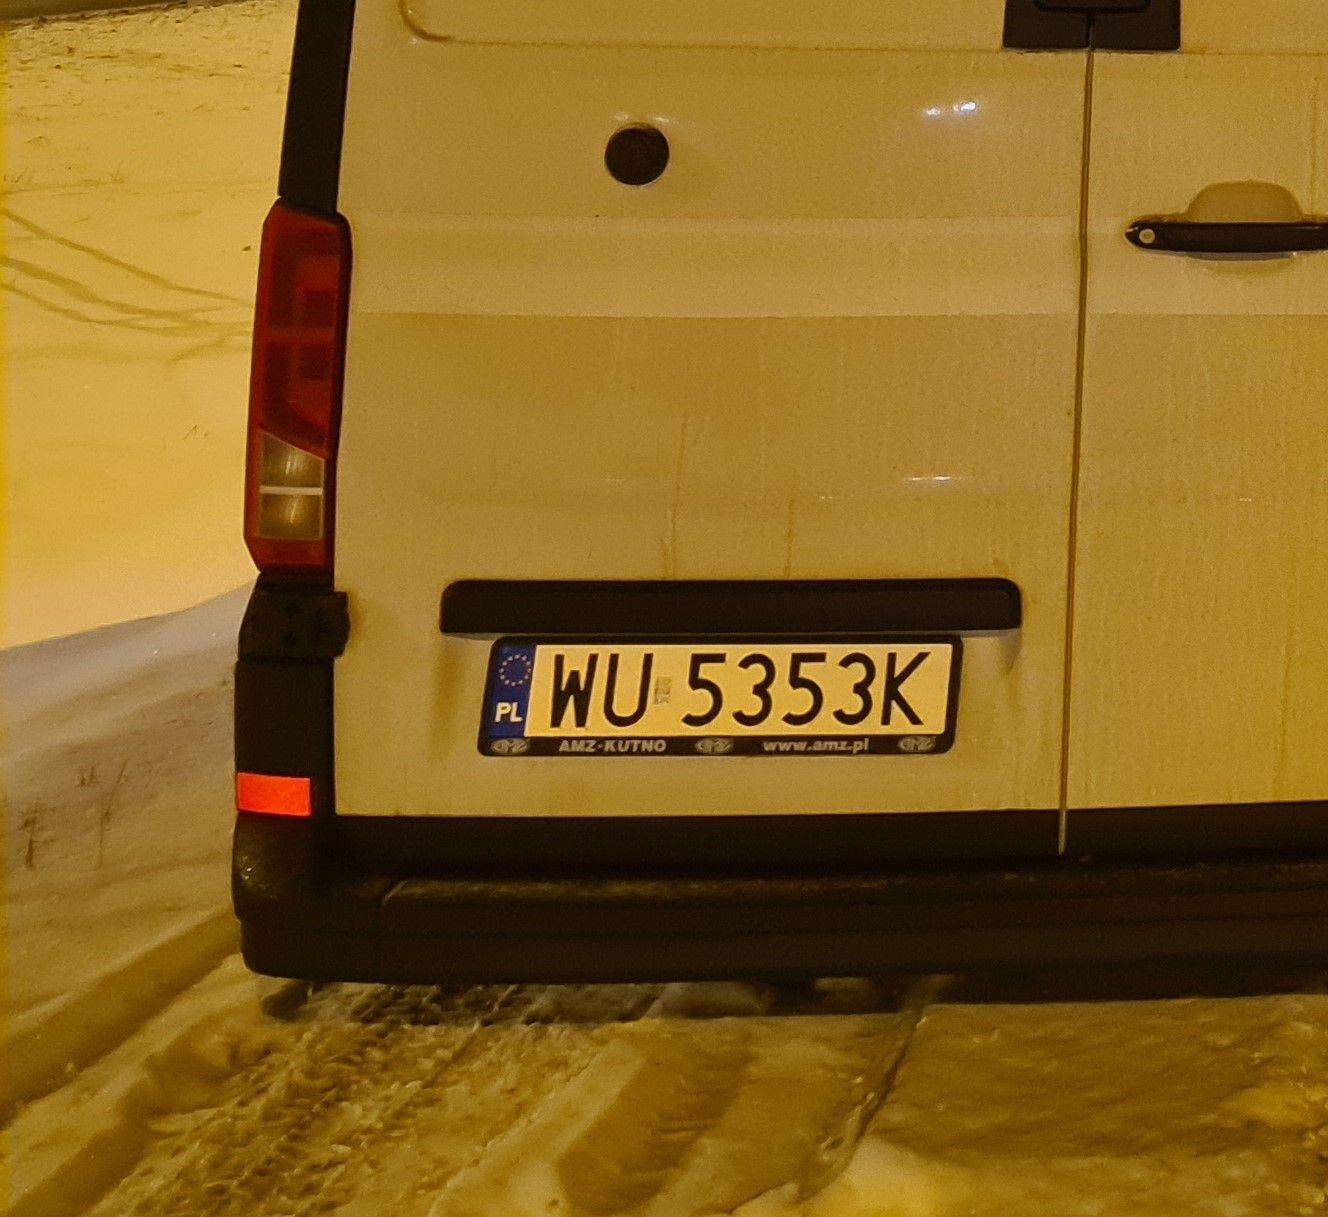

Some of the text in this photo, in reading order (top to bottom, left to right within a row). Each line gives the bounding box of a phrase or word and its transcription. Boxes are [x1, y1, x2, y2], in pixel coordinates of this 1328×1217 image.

[550, 651, 931, 728] WU 5353K
[494, 701, 523, 723] PL
[558, 739, 667, 753] AMZ-KUTNO
[762, 738, 870, 754] www.amz.pl
